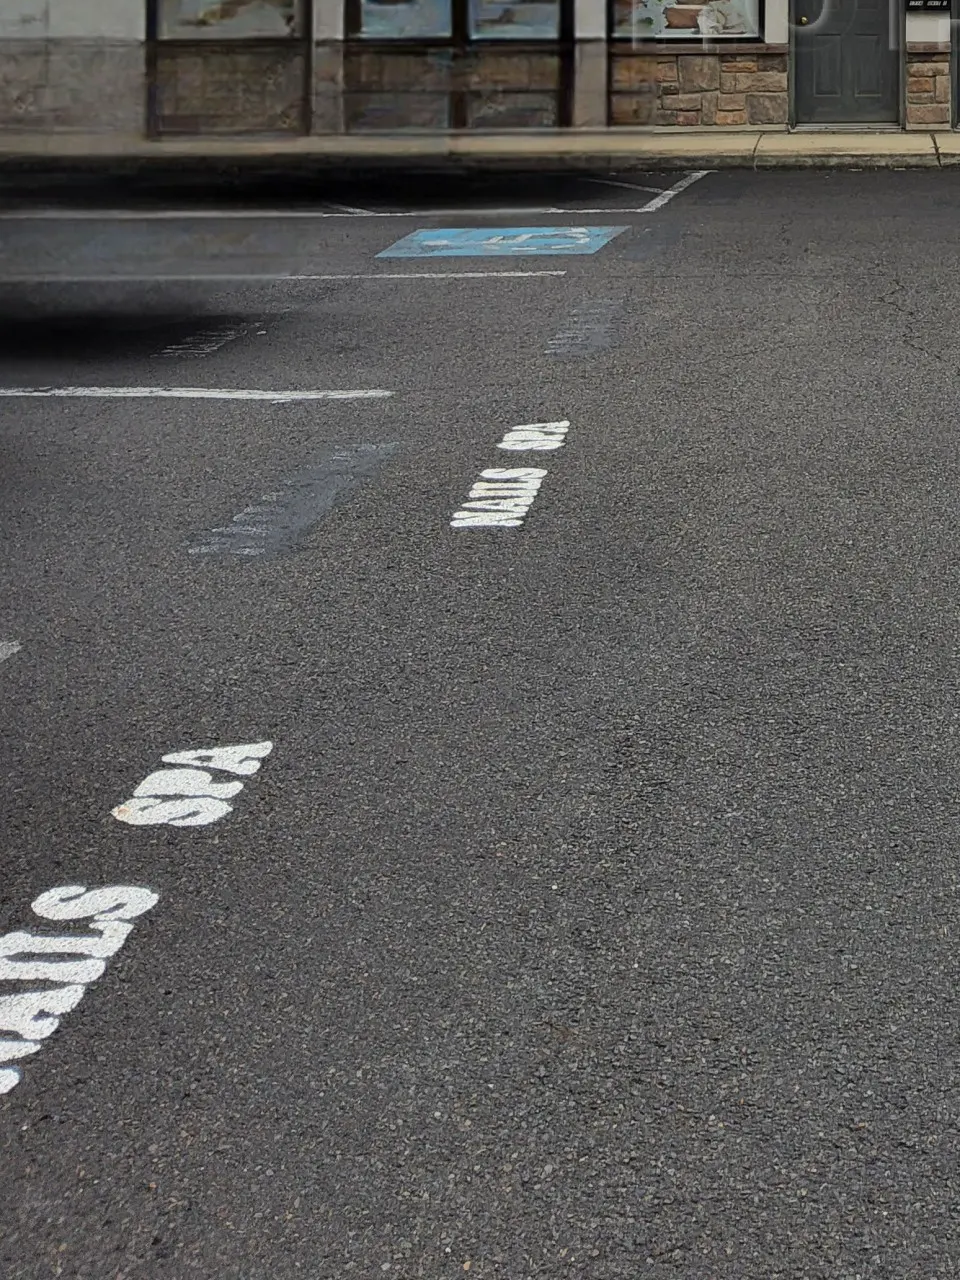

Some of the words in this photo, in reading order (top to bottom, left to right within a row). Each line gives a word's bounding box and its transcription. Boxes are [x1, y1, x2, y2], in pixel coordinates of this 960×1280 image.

[496, 420, 571, 451] SPA
[450, 467, 548, 528] NAILS
[111, 740, 273, 827] SPA
